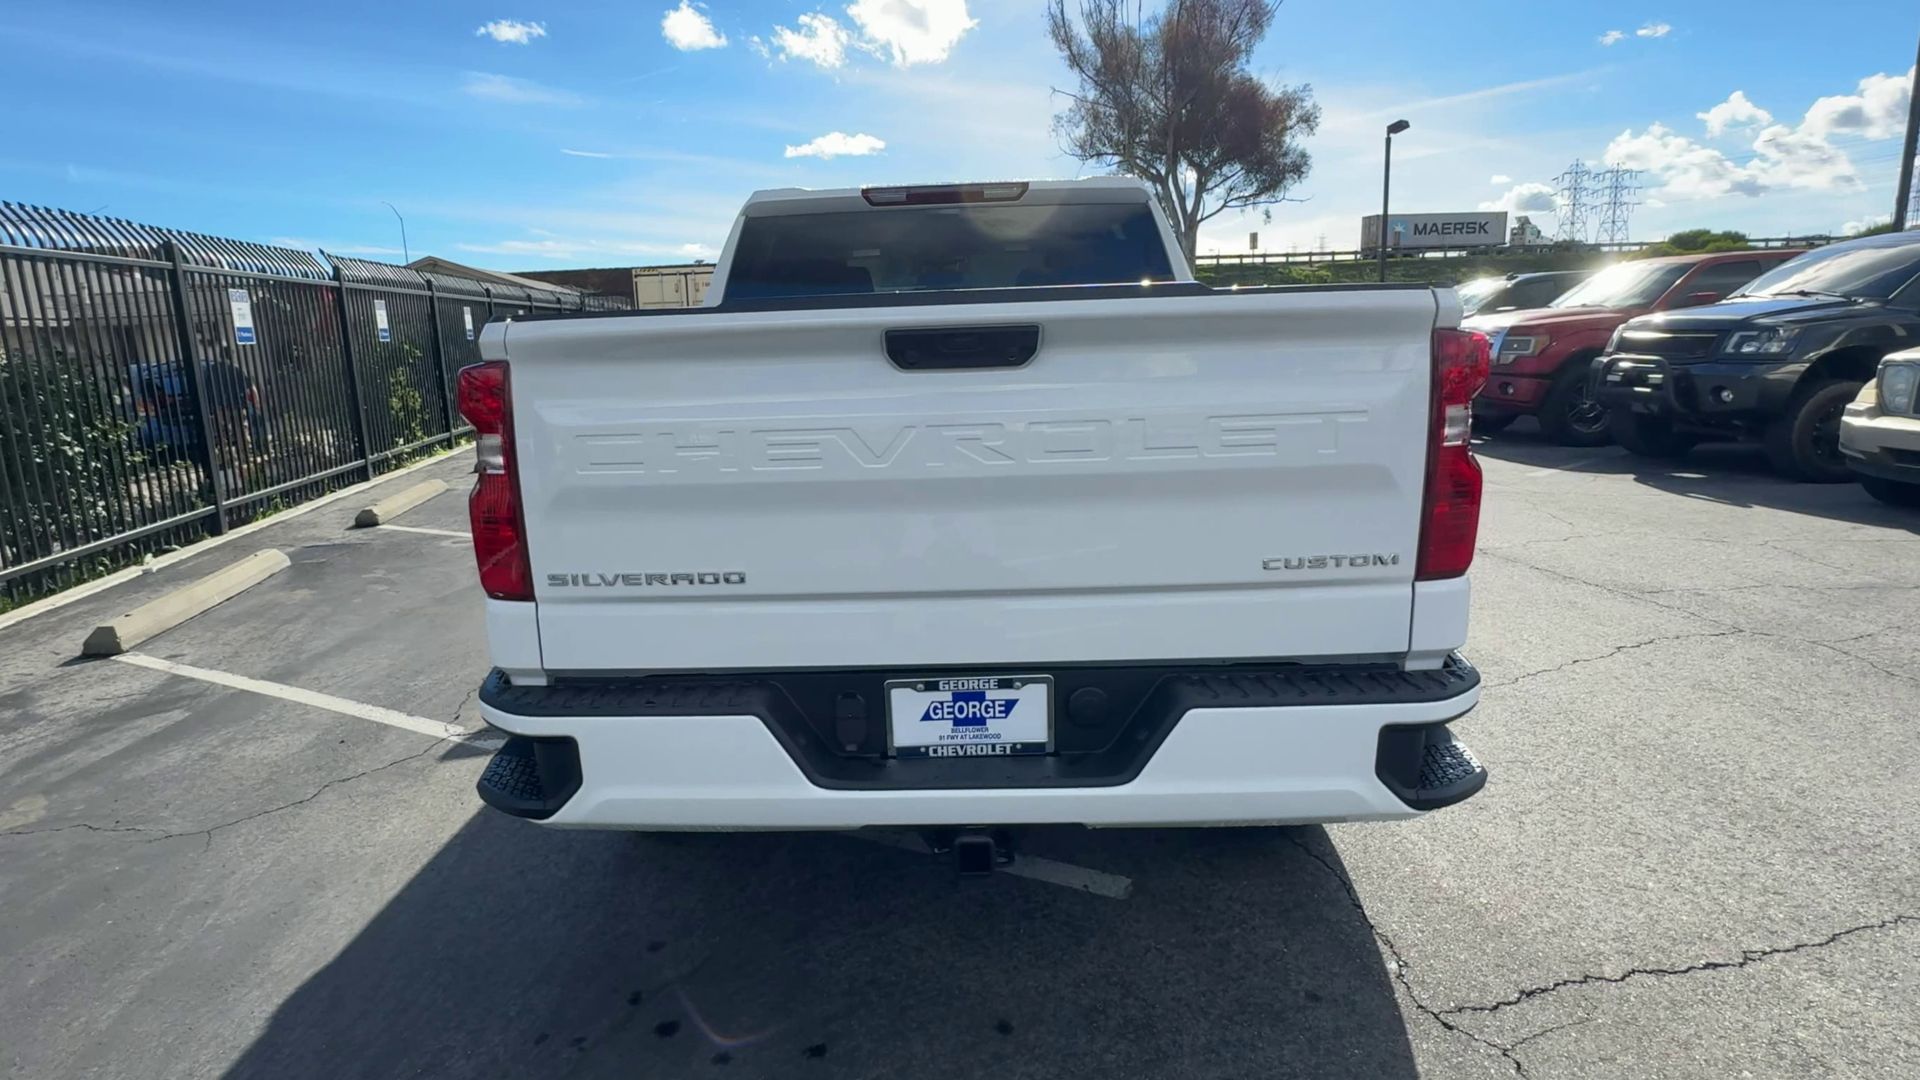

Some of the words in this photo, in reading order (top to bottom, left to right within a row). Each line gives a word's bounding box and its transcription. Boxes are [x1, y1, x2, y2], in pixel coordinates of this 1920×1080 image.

[1413, 221, 1490, 236] MAERSK
[575, 410, 1369, 475] CHEVROLET
[1262, 553, 1399, 571] CUSTOM
[547, 571, 746, 587] SILVERADO
[938, 678, 999, 691] GEORGE
[929, 701, 1006, 720] GEORGE
[951, 726, 989, 734] BELLFLOWER
[968, 732, 1002, 740] LAKEWOOD
[928, 743, 1013, 757] CHEVROLET
